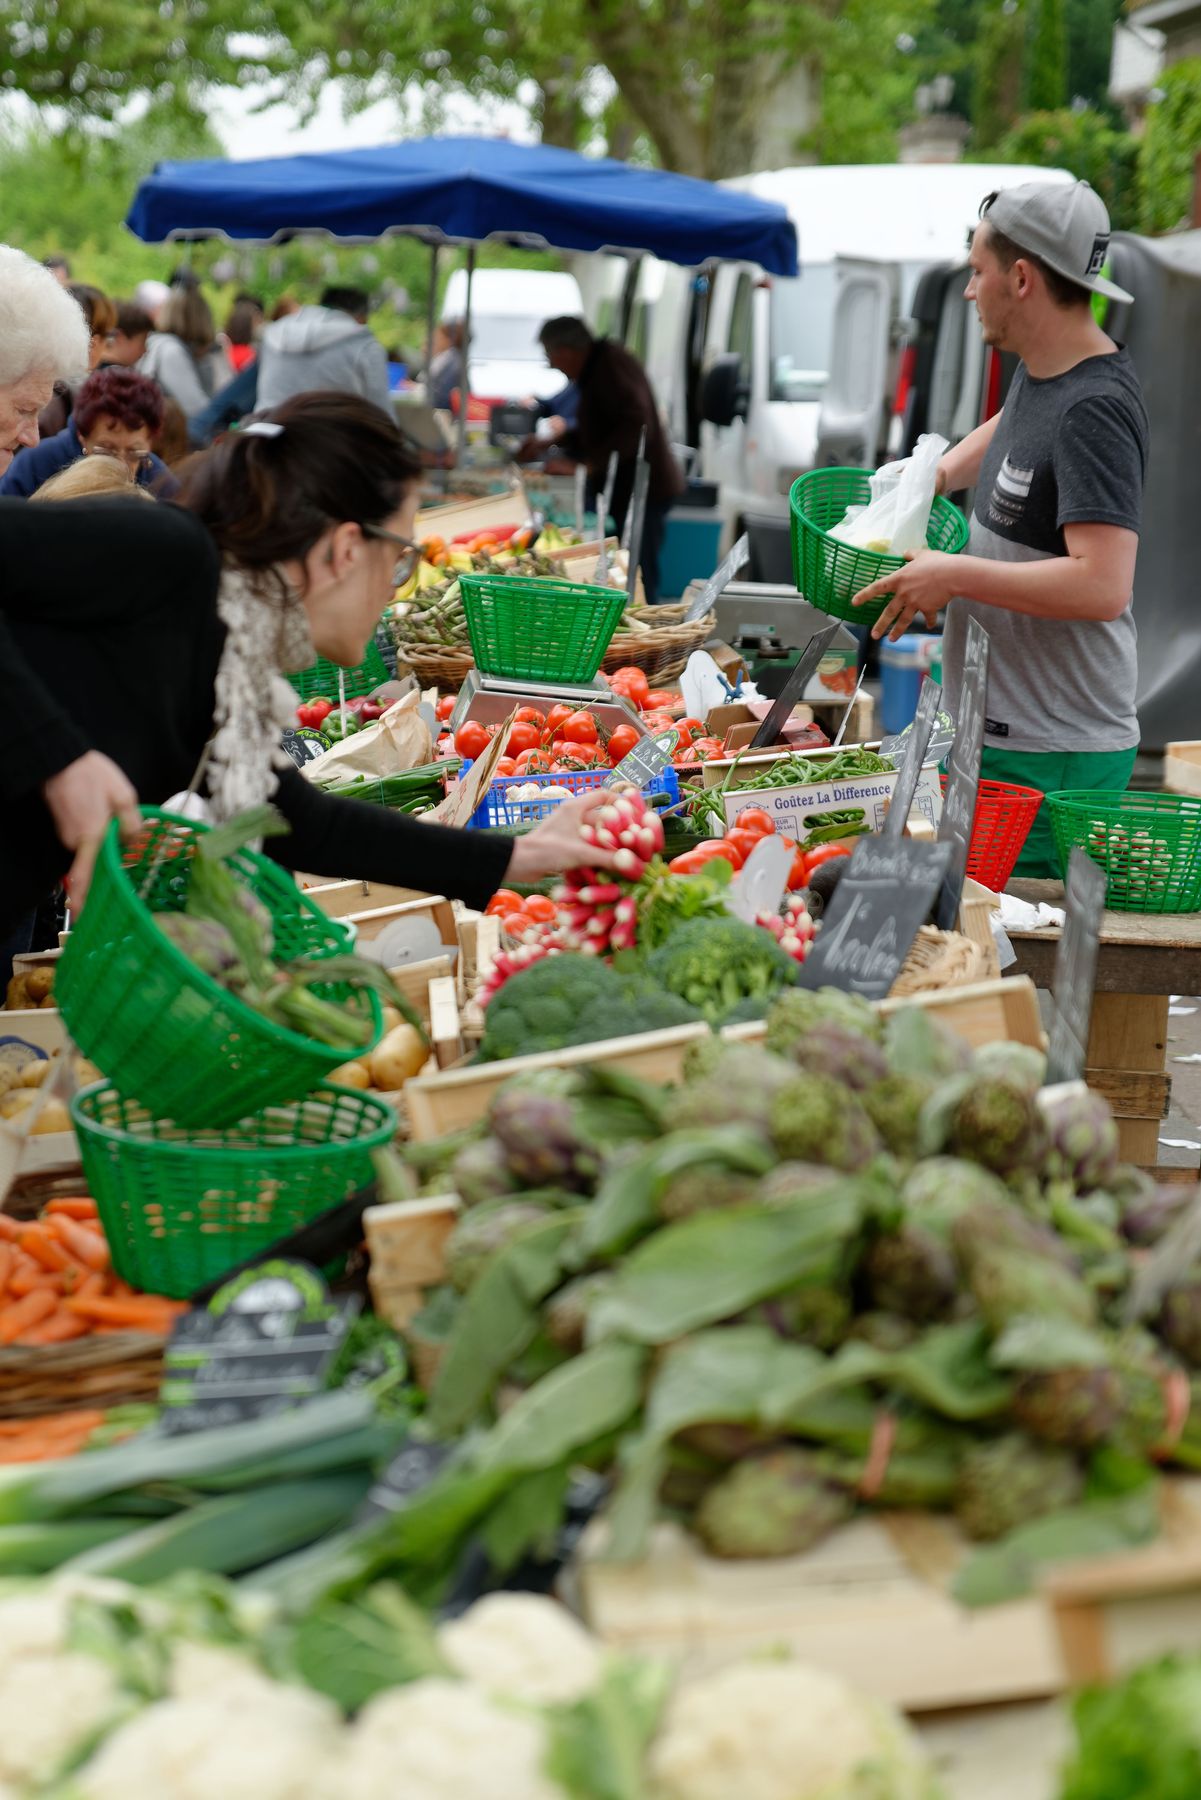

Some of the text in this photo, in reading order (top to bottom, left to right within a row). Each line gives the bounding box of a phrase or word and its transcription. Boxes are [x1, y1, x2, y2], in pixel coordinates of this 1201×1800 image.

[774, 784, 891, 810] Goûtez La Difference
